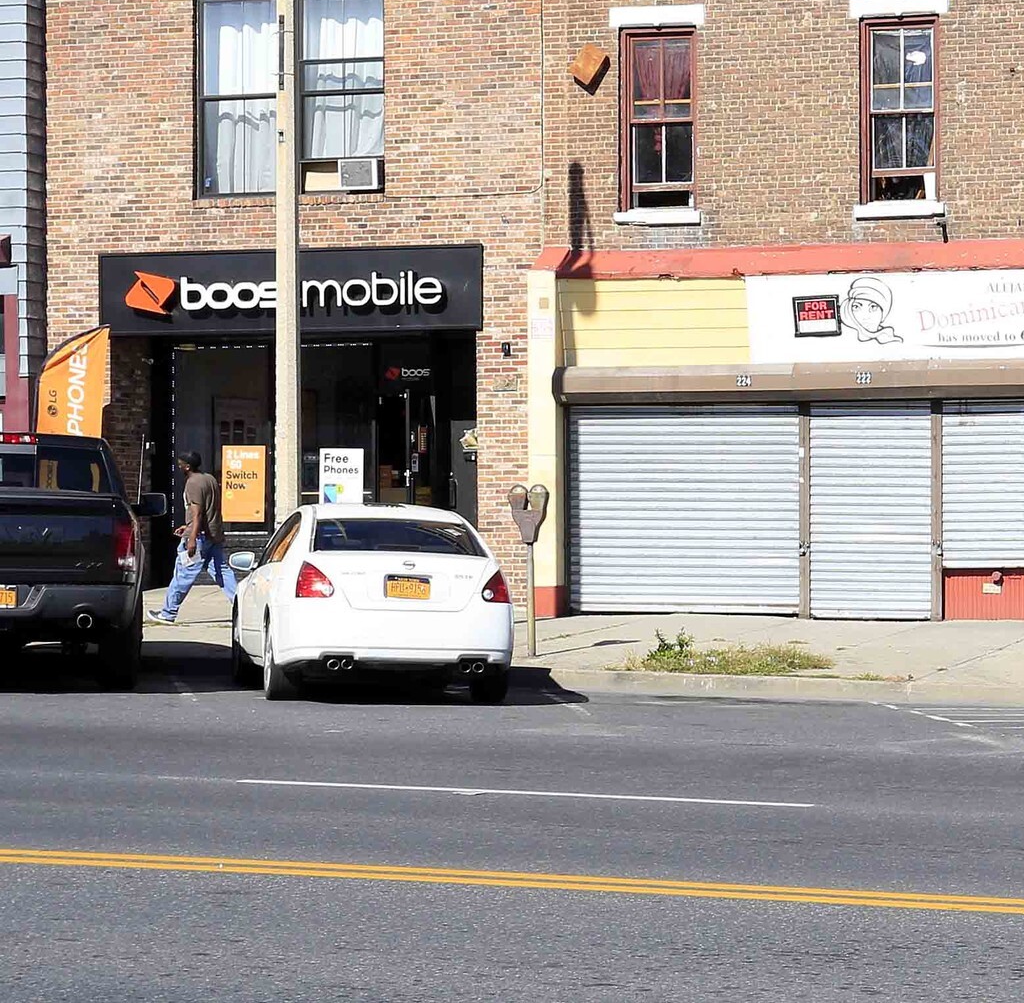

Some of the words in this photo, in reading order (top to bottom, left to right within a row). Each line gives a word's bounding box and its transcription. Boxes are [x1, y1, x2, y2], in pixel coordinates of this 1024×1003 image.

[180, 276, 276, 310] boos
[302, 270, 442, 308] mobile
[804, 301, 827, 311] FOR
[799, 309, 834, 320] RENT
[937, 332, 958, 343] has
[962, 331, 1001, 343] moved
[1004, 333, 1016, 342] to
[736, 375, 752, 387] 224
[856, 372, 872, 385] 222
[48, 389, 57, 404] LG
[323, 452, 349, 464] Free
[225, 470, 258, 480] Switch
[323, 464, 359, 475] Phones
[225, 481, 246, 490] Now
